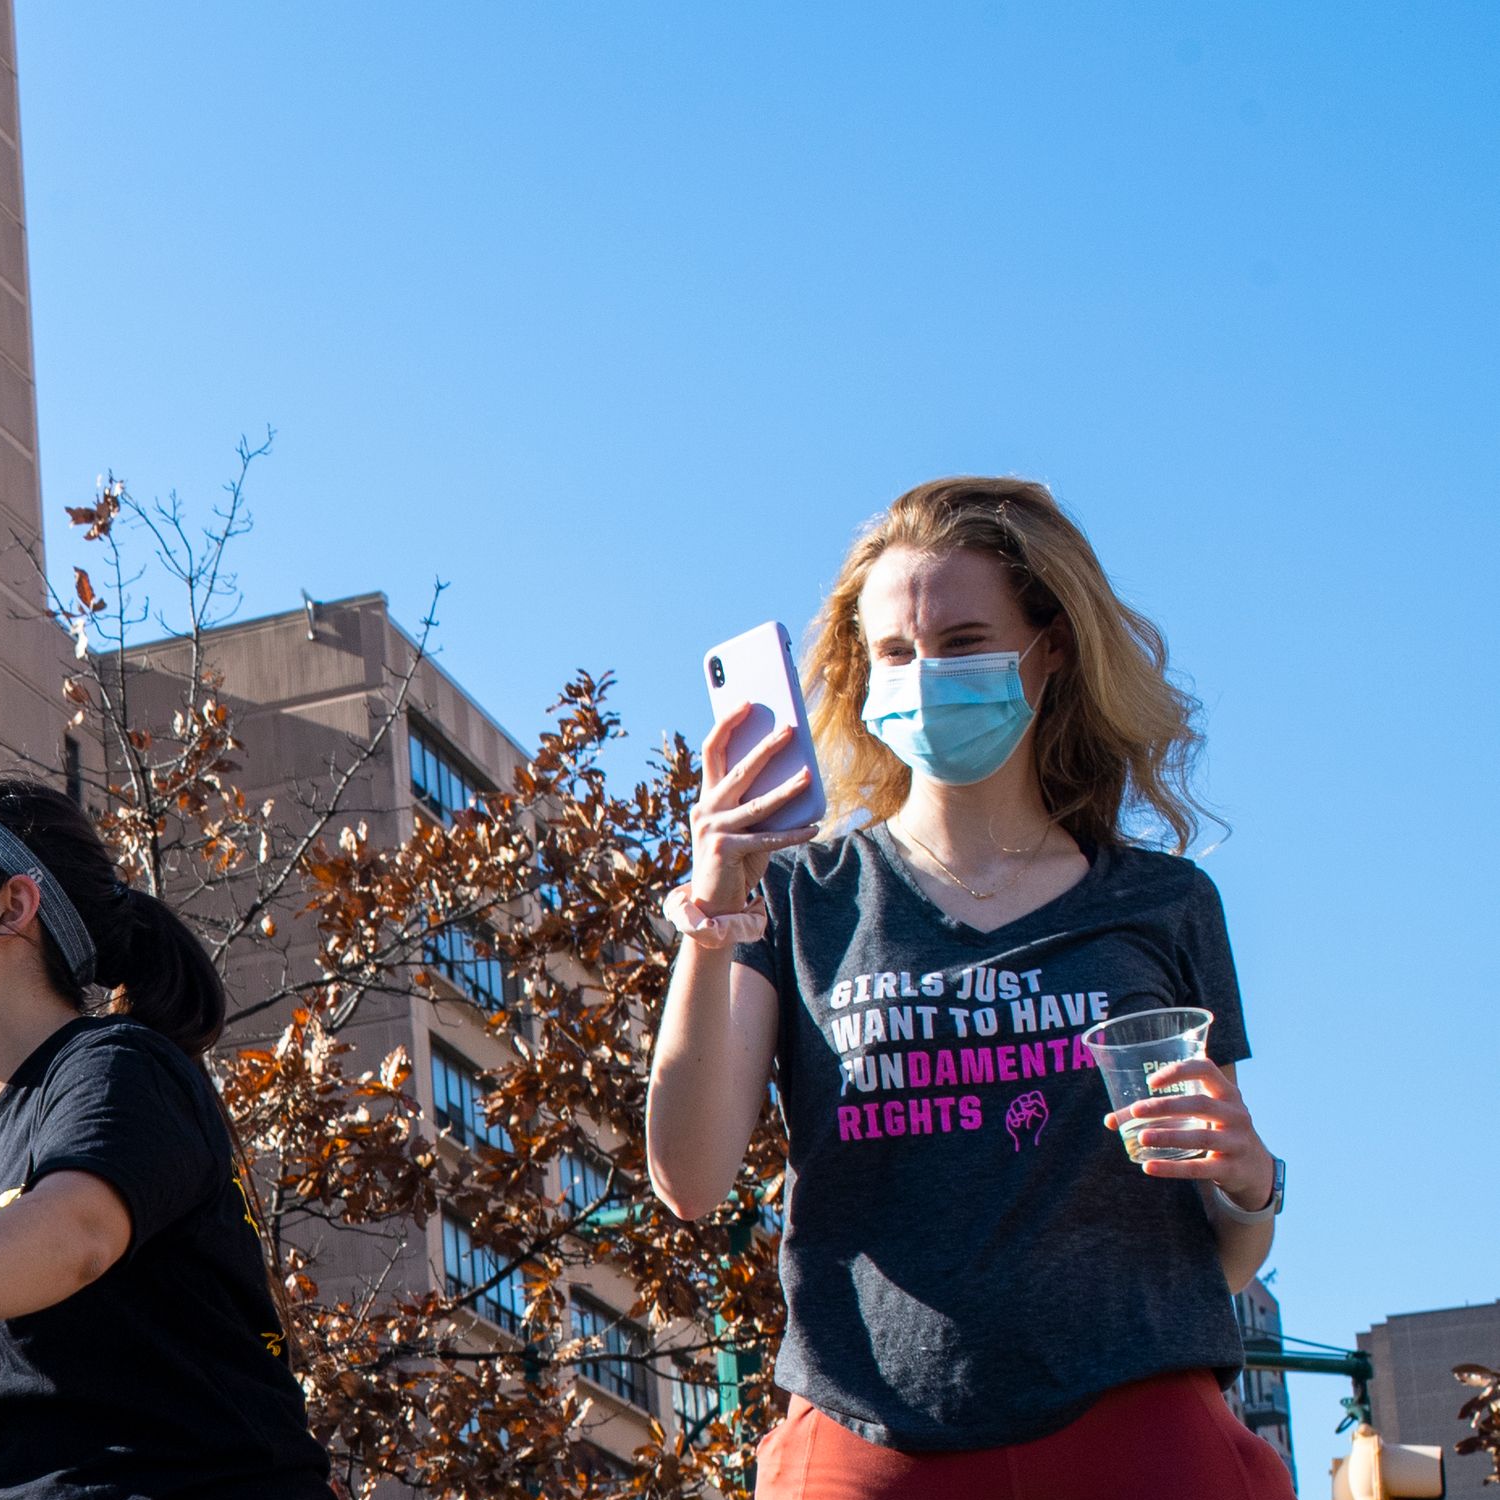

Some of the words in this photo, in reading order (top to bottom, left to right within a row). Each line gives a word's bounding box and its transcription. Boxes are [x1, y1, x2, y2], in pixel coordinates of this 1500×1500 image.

[830, 971, 944, 1009] GIRLS
[956, 967, 1042, 1003] JUST
[831, 1005, 938, 1054] WANT
[949, 1006, 998, 1038] TO
[1010, 991, 1109, 1034] HAVE
[837, 1095, 983, 1142] RIGHTS
